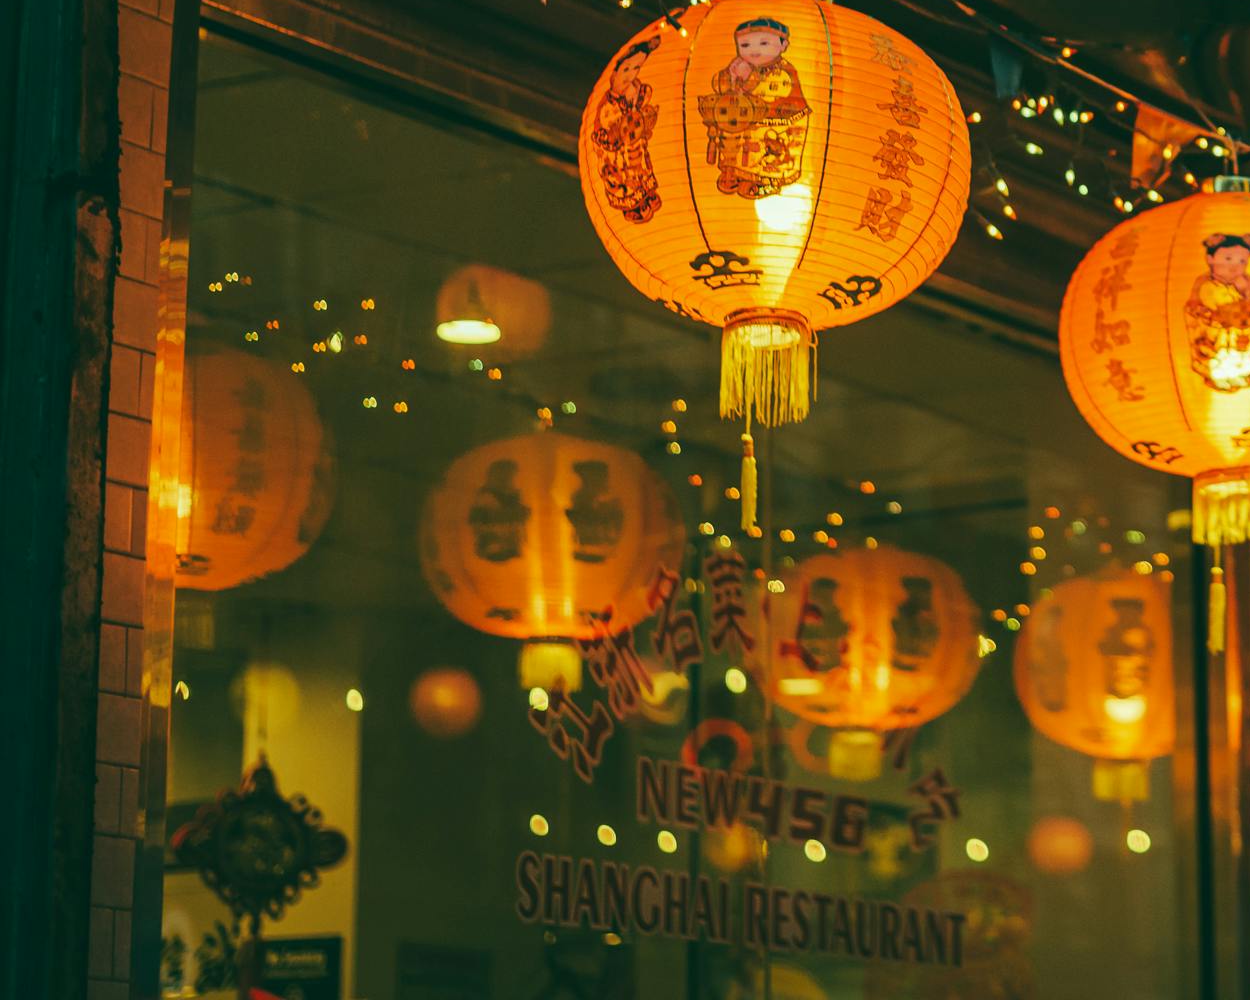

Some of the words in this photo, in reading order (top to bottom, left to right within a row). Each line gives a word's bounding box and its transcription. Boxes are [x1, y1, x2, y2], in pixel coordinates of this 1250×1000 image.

[636, 756, 744, 832] NEW
[744, 772, 872, 855] 456
[515, 850, 733, 946] SHANGHAI
[745, 881, 967, 969] RESTAURANT
